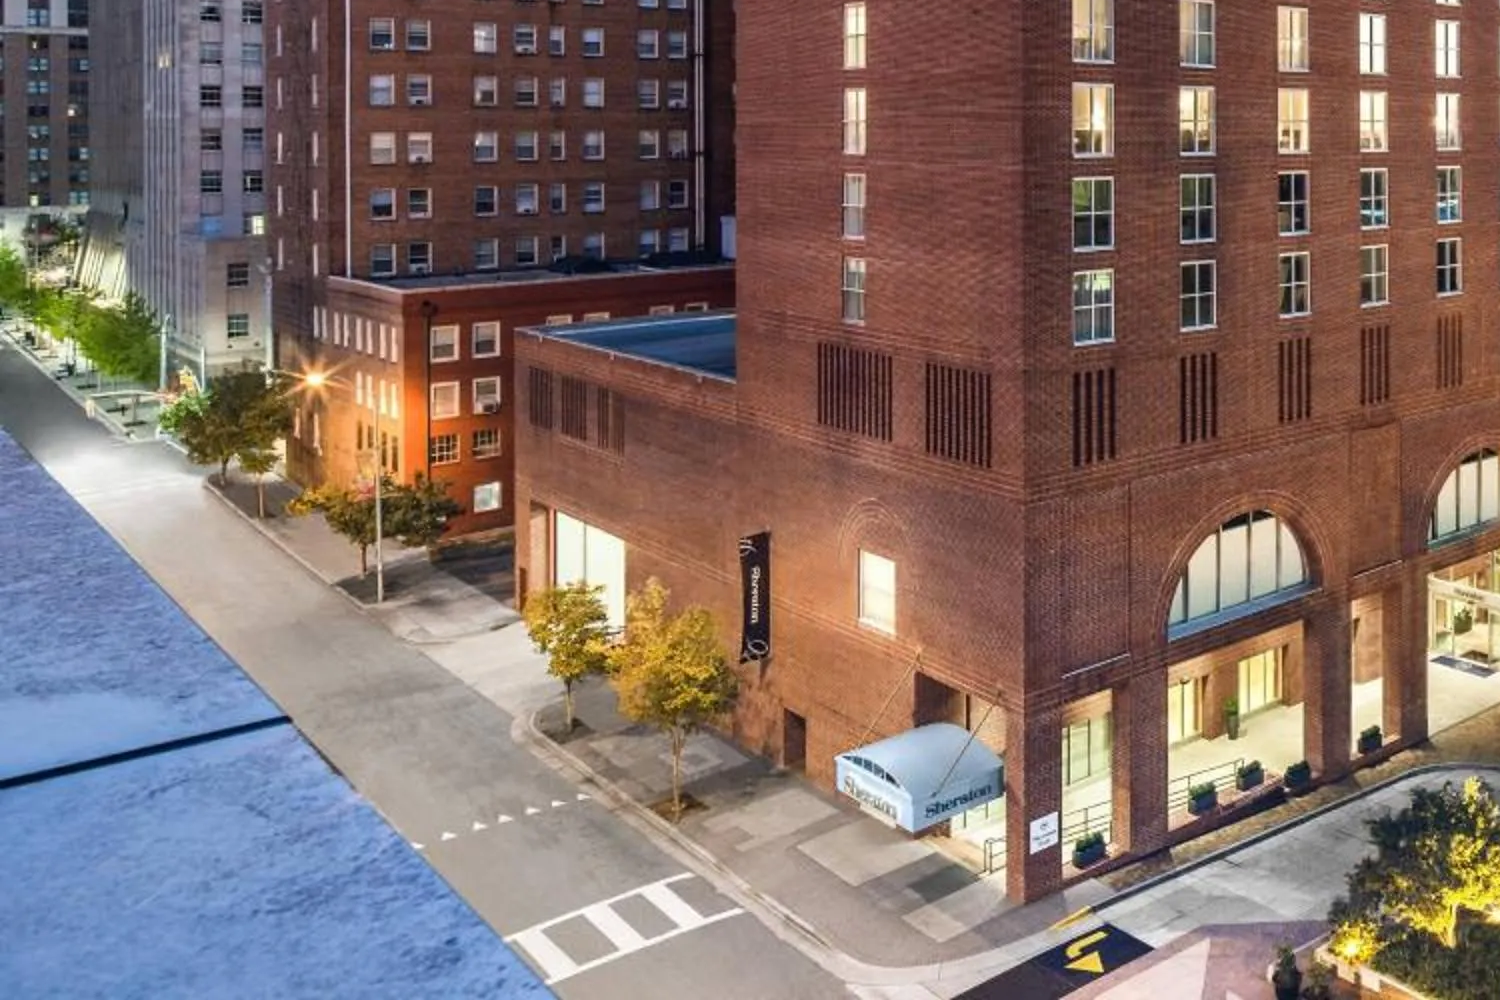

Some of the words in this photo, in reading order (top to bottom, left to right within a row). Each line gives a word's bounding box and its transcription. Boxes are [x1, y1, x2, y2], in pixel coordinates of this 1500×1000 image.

[750, 565, 761, 625] Sheraton
[843, 775, 898, 820] Sheraton
[925, 783, 992, 818] Sheraton
